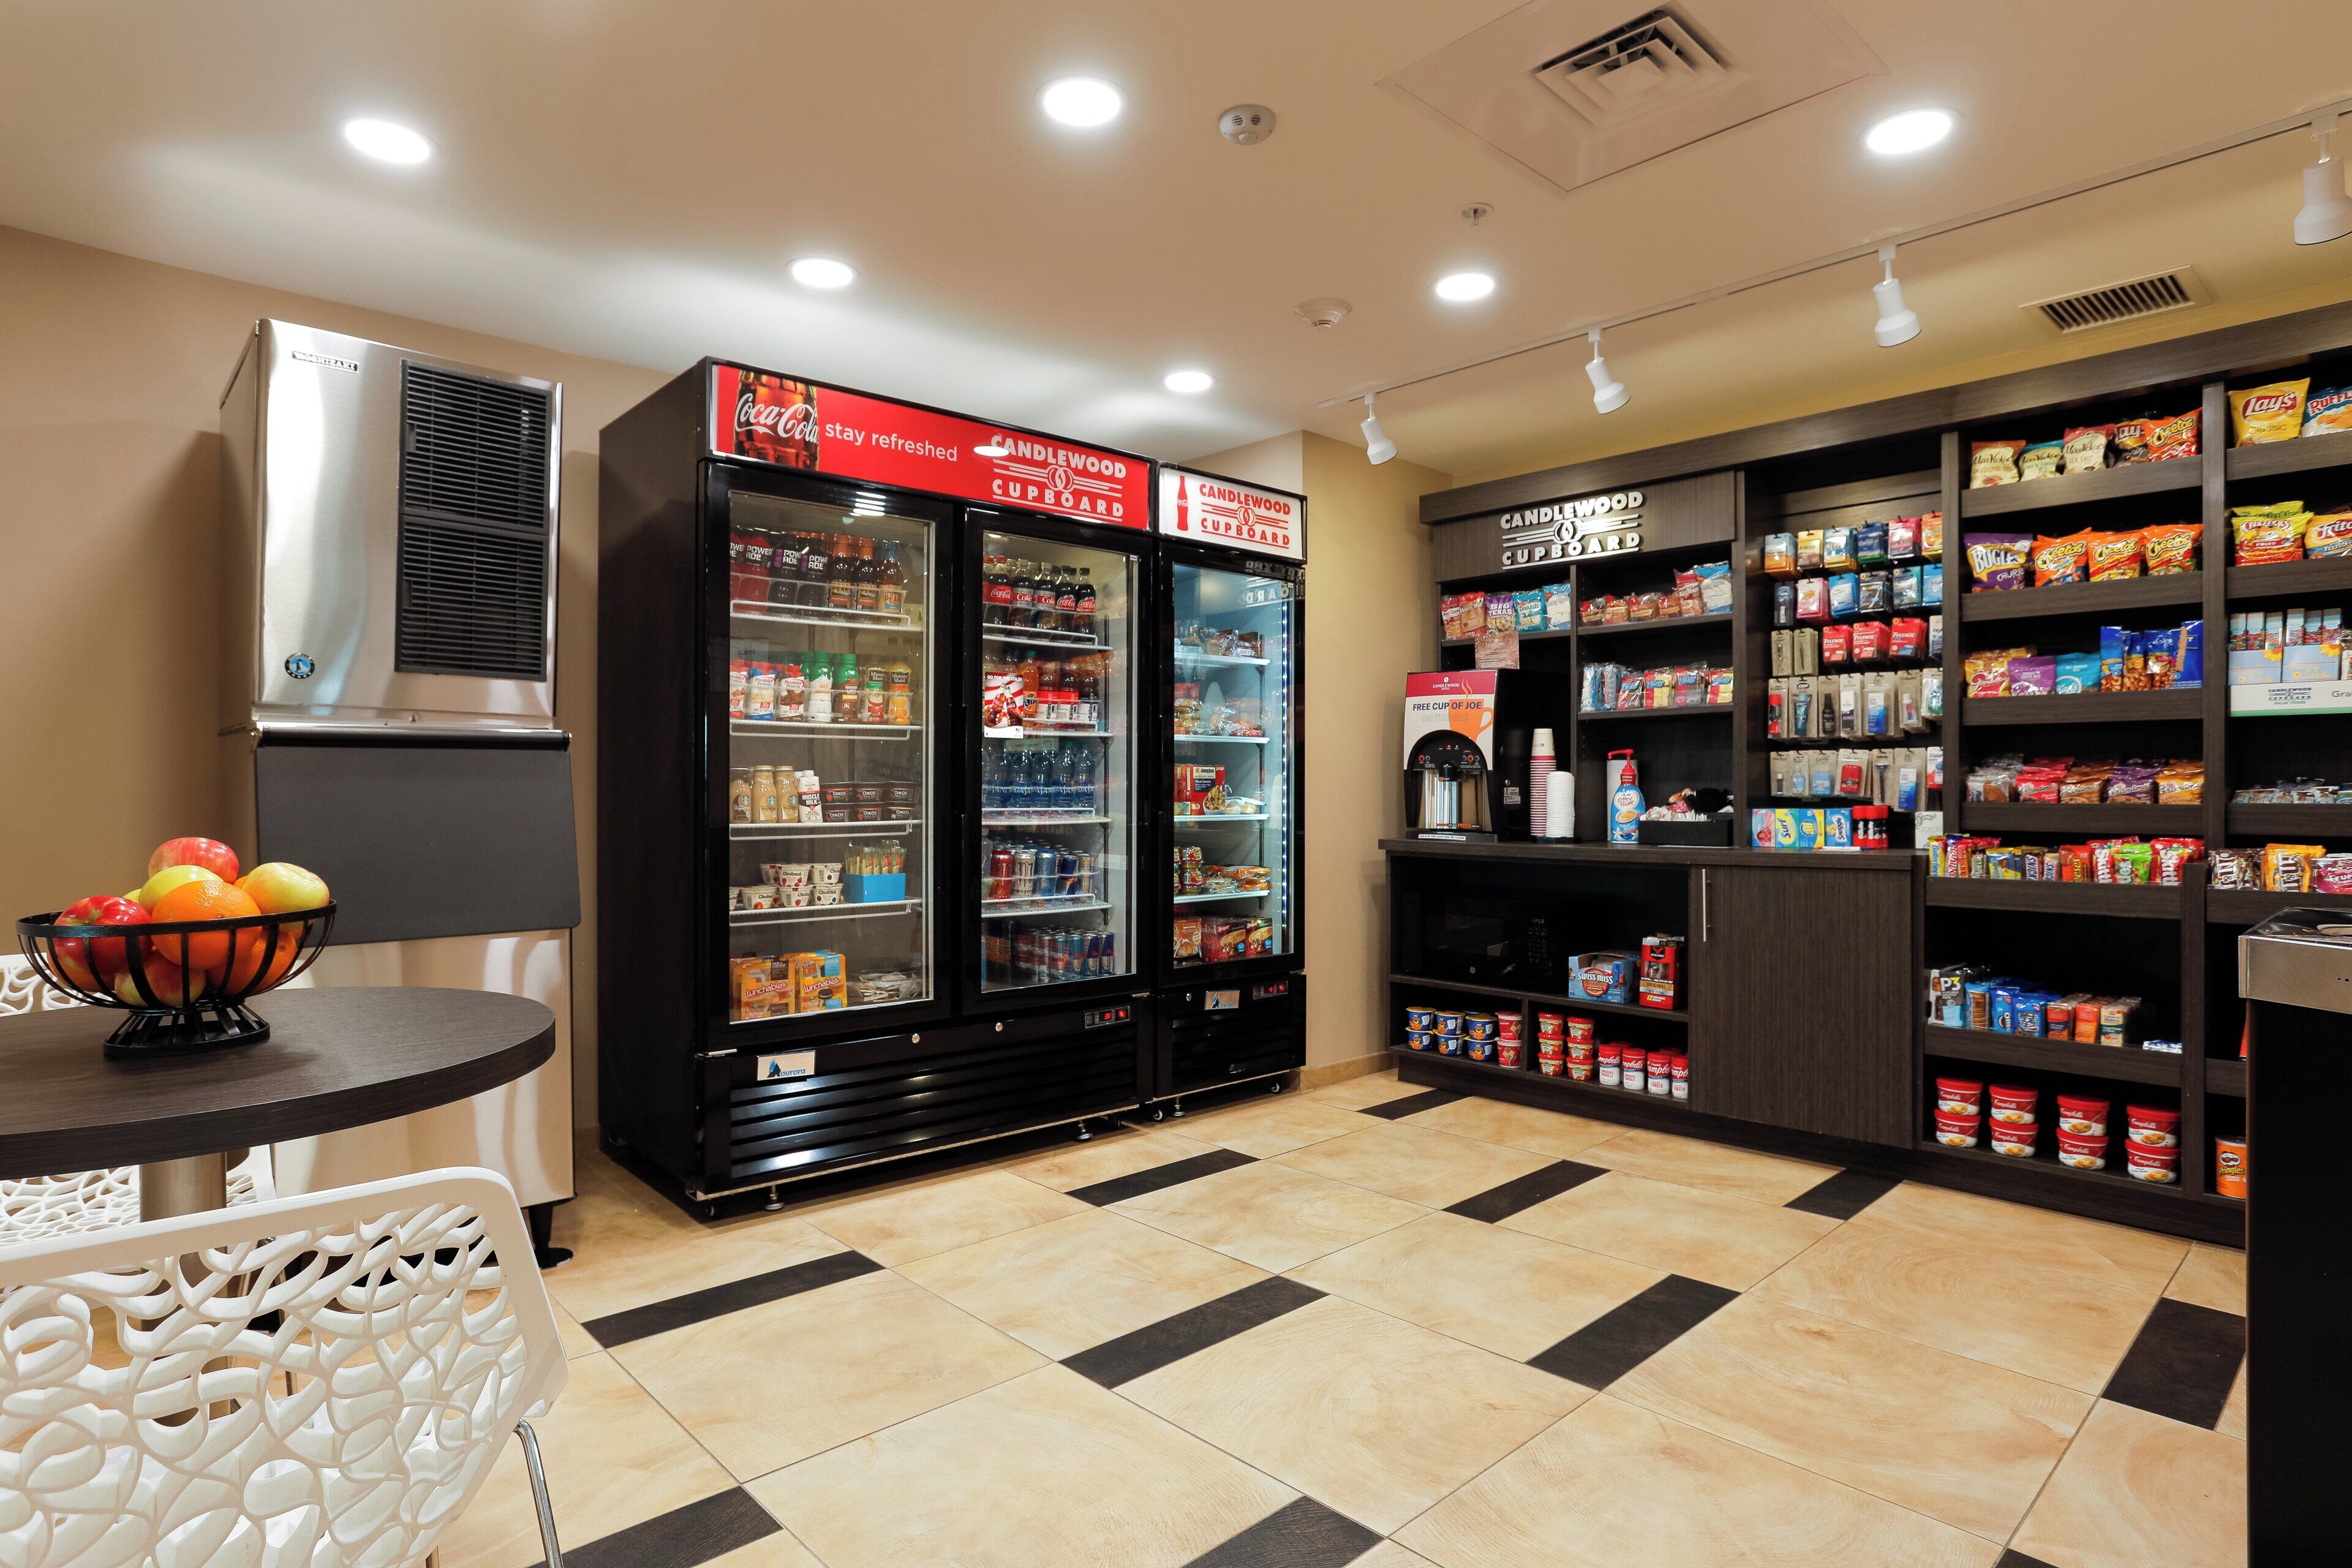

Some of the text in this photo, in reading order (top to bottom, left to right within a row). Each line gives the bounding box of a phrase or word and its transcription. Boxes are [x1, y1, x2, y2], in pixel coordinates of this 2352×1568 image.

[2307, 391, 2352, 417] RUFFL
[734, 393, 818, 445] Coca-Cola
[2248, 423, 2287, 435] Classic
[825, 422, 957, 462] stay refreshed
[2151, 418, 2195, 447] Cheetos
[990, 434, 1126, 479] CANDLEWOOD
[992, 479, 1123, 517] CUPBOARD
[1199, 483, 1291, 516] CANDLEWOOD
[1501, 491, 1643, 529] CANDLEWOOD
[1200, 518, 1290, 546] CUPBOARD
[2315, 518, 2352, 540] Frito
[745, 552, 761, 561] ADE
[747, 545, 772, 556] POWER
[1502, 532, 1640, 565] CUPBOARD
[2036, 541, 2086, 570] Cheetos
[2094, 539, 2136, 564] Cheetos
[2147, 534, 2191, 559] Cheetos
[808, 562, 824, 570] ADE
[809, 554, 828, 564] POWE
[1017, 593, 1033, 601] Coke
[1678, 676, 1697, 685] ZINGERS
[1413, 703, 1431, 711] FREE
[1421, 714, 1433, 722] ON
[1777, 817, 1792, 839] Surf
[2026, 854, 2038, 881] SNICK
[747, 981, 786, 997] Lunchables
[804, 977, 839, 993] Lunchables
[1940, 976, 1961, 991] P3
[1598, 1056, 1621, 1065] ampbell's
[780, 1068, 805, 1076] aurora
[2218, 1166, 2244, 1175] Pringles
